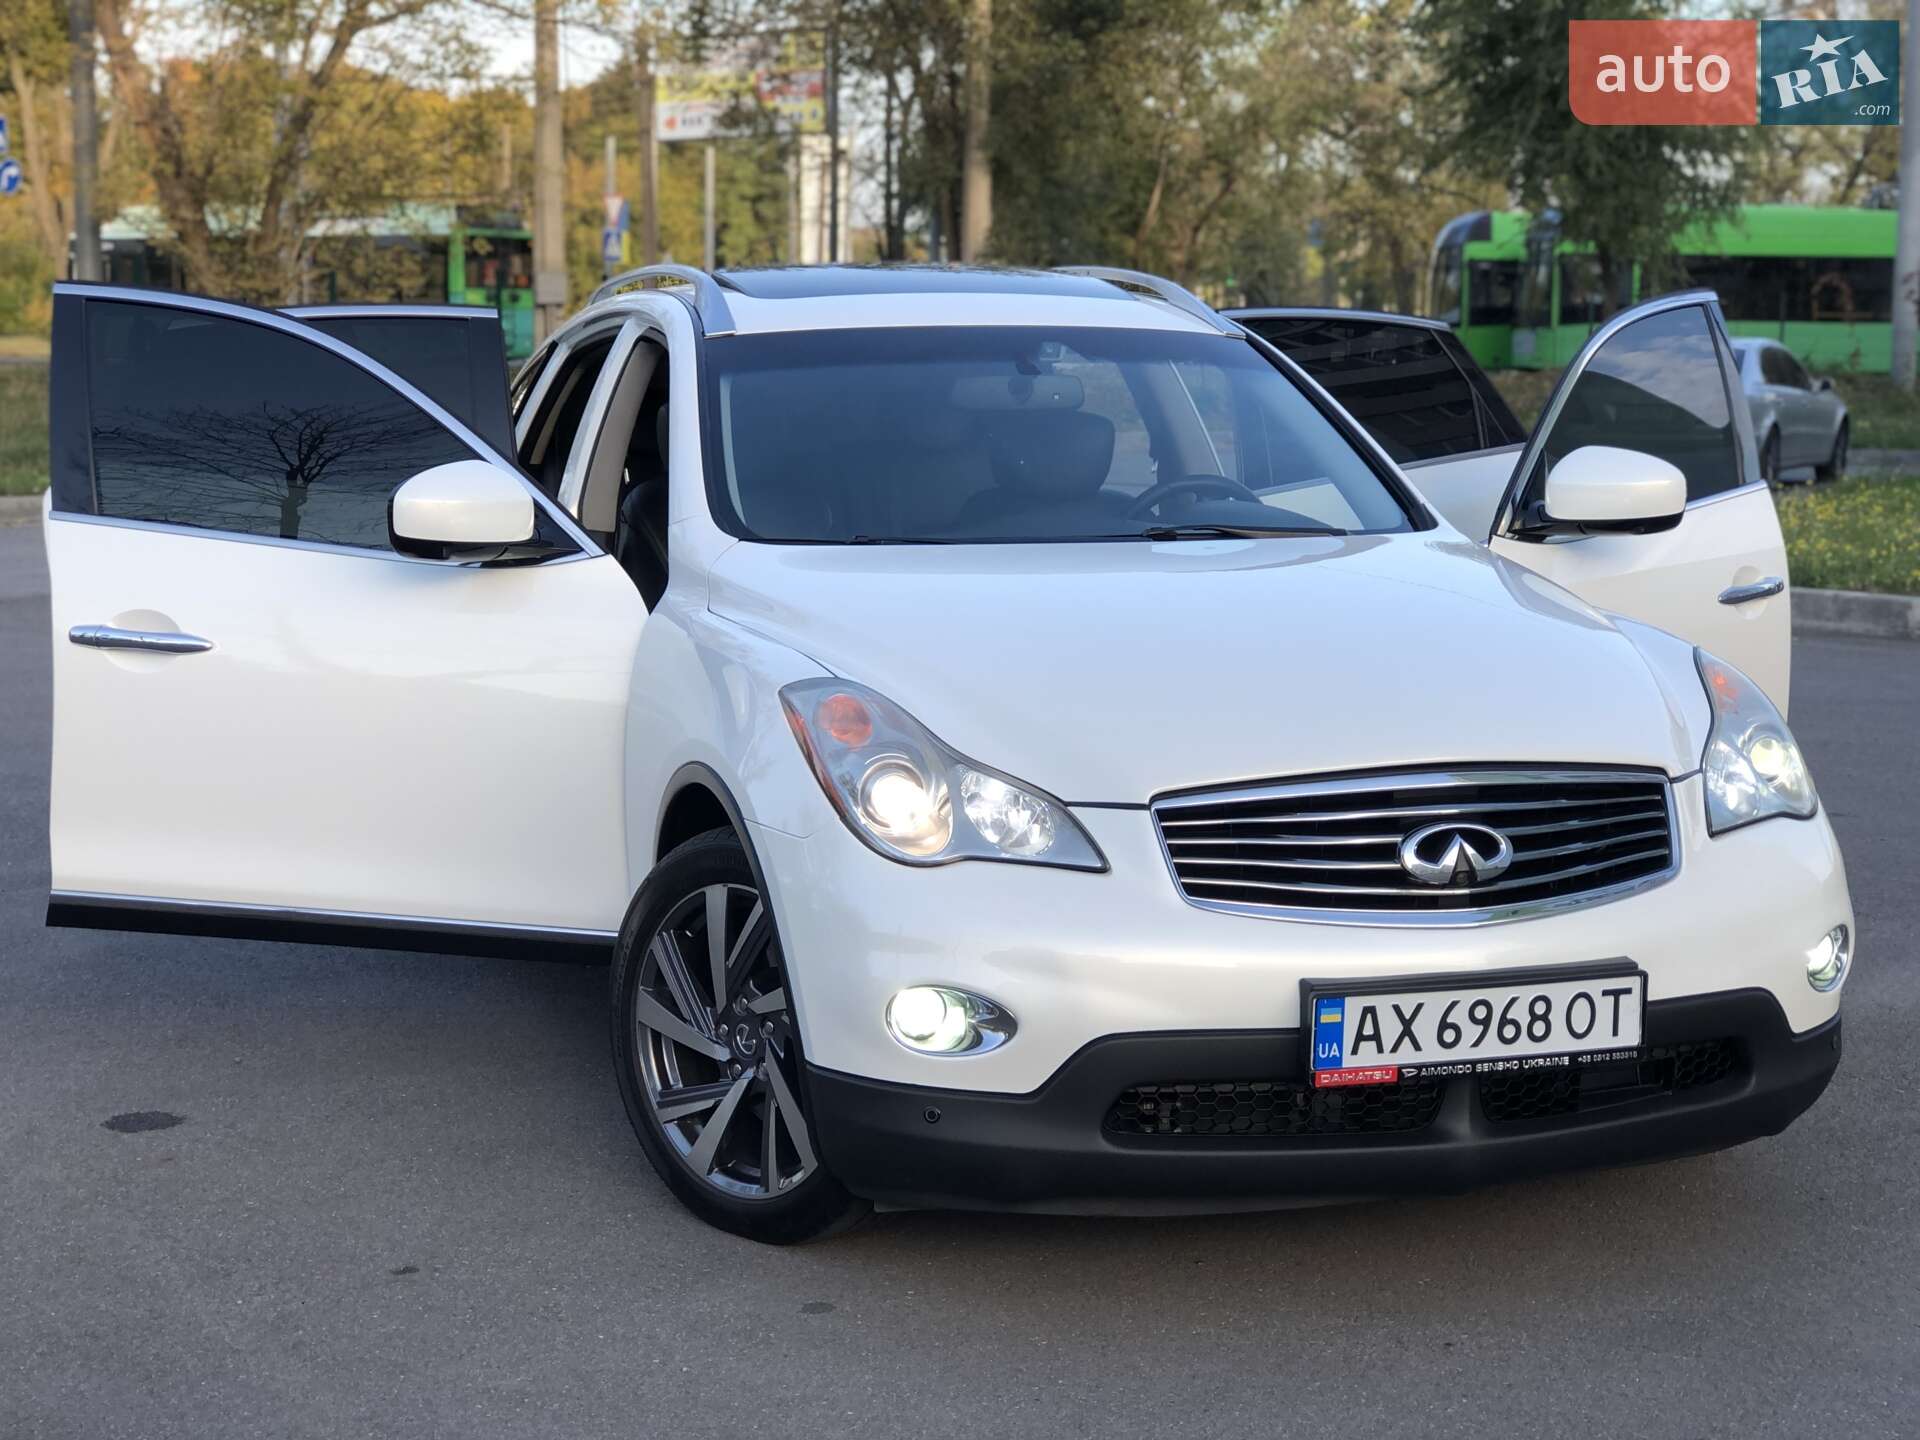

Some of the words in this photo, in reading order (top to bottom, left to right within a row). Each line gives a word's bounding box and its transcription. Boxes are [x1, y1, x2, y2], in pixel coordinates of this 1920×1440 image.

[1351, 1002, 1425, 1056] AX
[1436, 994, 1552, 1050] 6968
[1565, 987, 1633, 1040] OT
[1318, 1043, 1340, 1058] UA
[1523, 1056, 1570, 1069] UKRAINE
[1320, 1070, 1392, 1083] DAIHATSU
